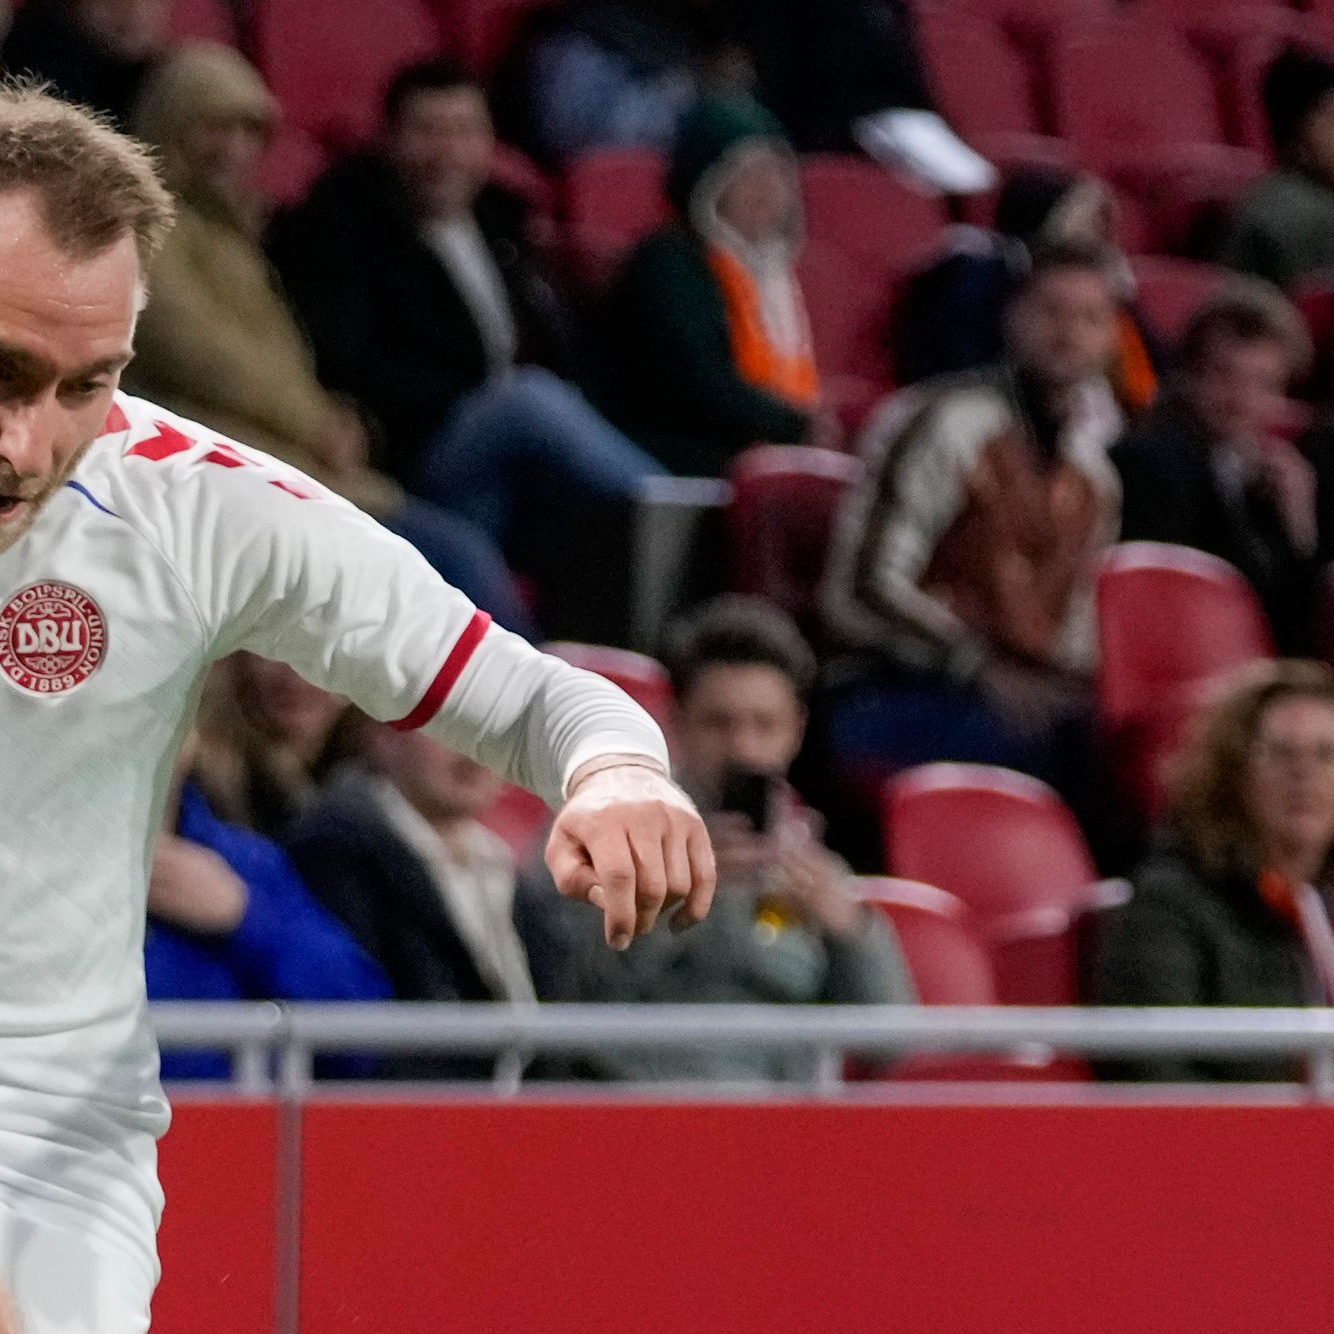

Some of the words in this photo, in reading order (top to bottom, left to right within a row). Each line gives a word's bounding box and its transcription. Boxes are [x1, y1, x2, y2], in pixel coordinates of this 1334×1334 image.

[16, 618, 83, 654] DBU
[79, 614, 104, 676] UNION
[29, 675, 75, 692] 1889
